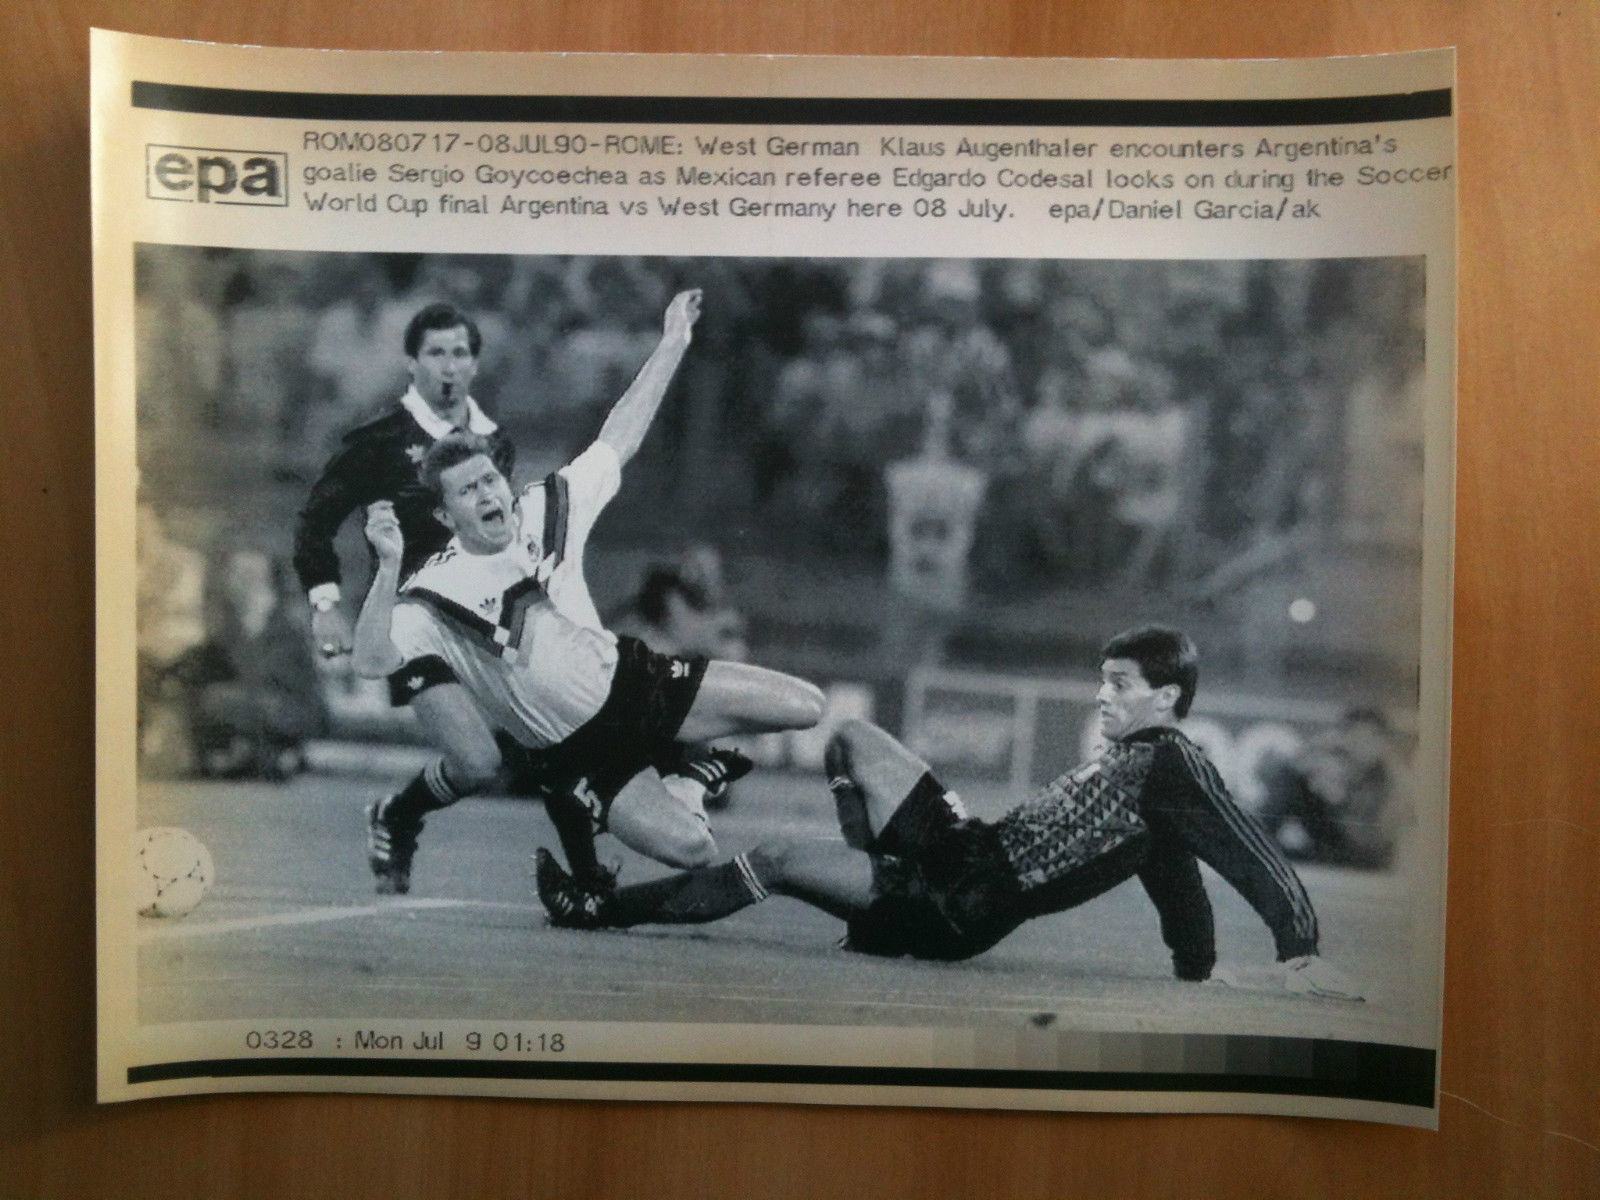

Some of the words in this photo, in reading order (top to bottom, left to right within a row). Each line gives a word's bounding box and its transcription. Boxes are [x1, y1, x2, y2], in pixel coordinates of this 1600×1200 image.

[694, 136, 757, 156] West
[766, 136, 859, 156] German
[880, 137, 946, 157] Klaus
[956, 137, 1098, 162] Augenthaler
[1109, 140, 1244, 159] encounters
[1255, 134, 1397, 162] Argentina's
[154, 152, 282, 204] epa
[303, 162, 377, 186] goalie
[387, 162, 465, 188] Sergio
[475, 164, 628, 189] Goycoechea
[638, 170, 666, 186] as
[676, 166, 776, 187] Mexican
[785, 167, 882, 187] referee
[893, 167, 986, 192] Edgardo
[997, 168, 1093, 188] Codesal
[1106, 169, 1174, 189] looks
[1184, 173, 1215, 189] on
[1224, 169, 1296, 193] during
[1305, 168, 1344, 187] the
[1357, 164, 1453, 186] Soccer
[303, 192, 377, 213] World
[386, 194, 429, 218] Cup
[438, 194, 489, 214] final
[500, 195, 610, 219] Argentina
[619, 200, 648, 216] vs
[657, 196, 720, 216] West
[728, 197, 838, 222] Germany
[847, 198, 903, 218] here
[913, 197, 947, 218] 08
[958, 198, 1015, 223] July.
[245, 1030, 313, 1049] 0328
[355, 1030, 403, 1050] Mon
[413, 1031, 444, 1051] Jul
[466, 1031, 482, 1052] 9
[493, 1032, 565, 1053] 01:18
